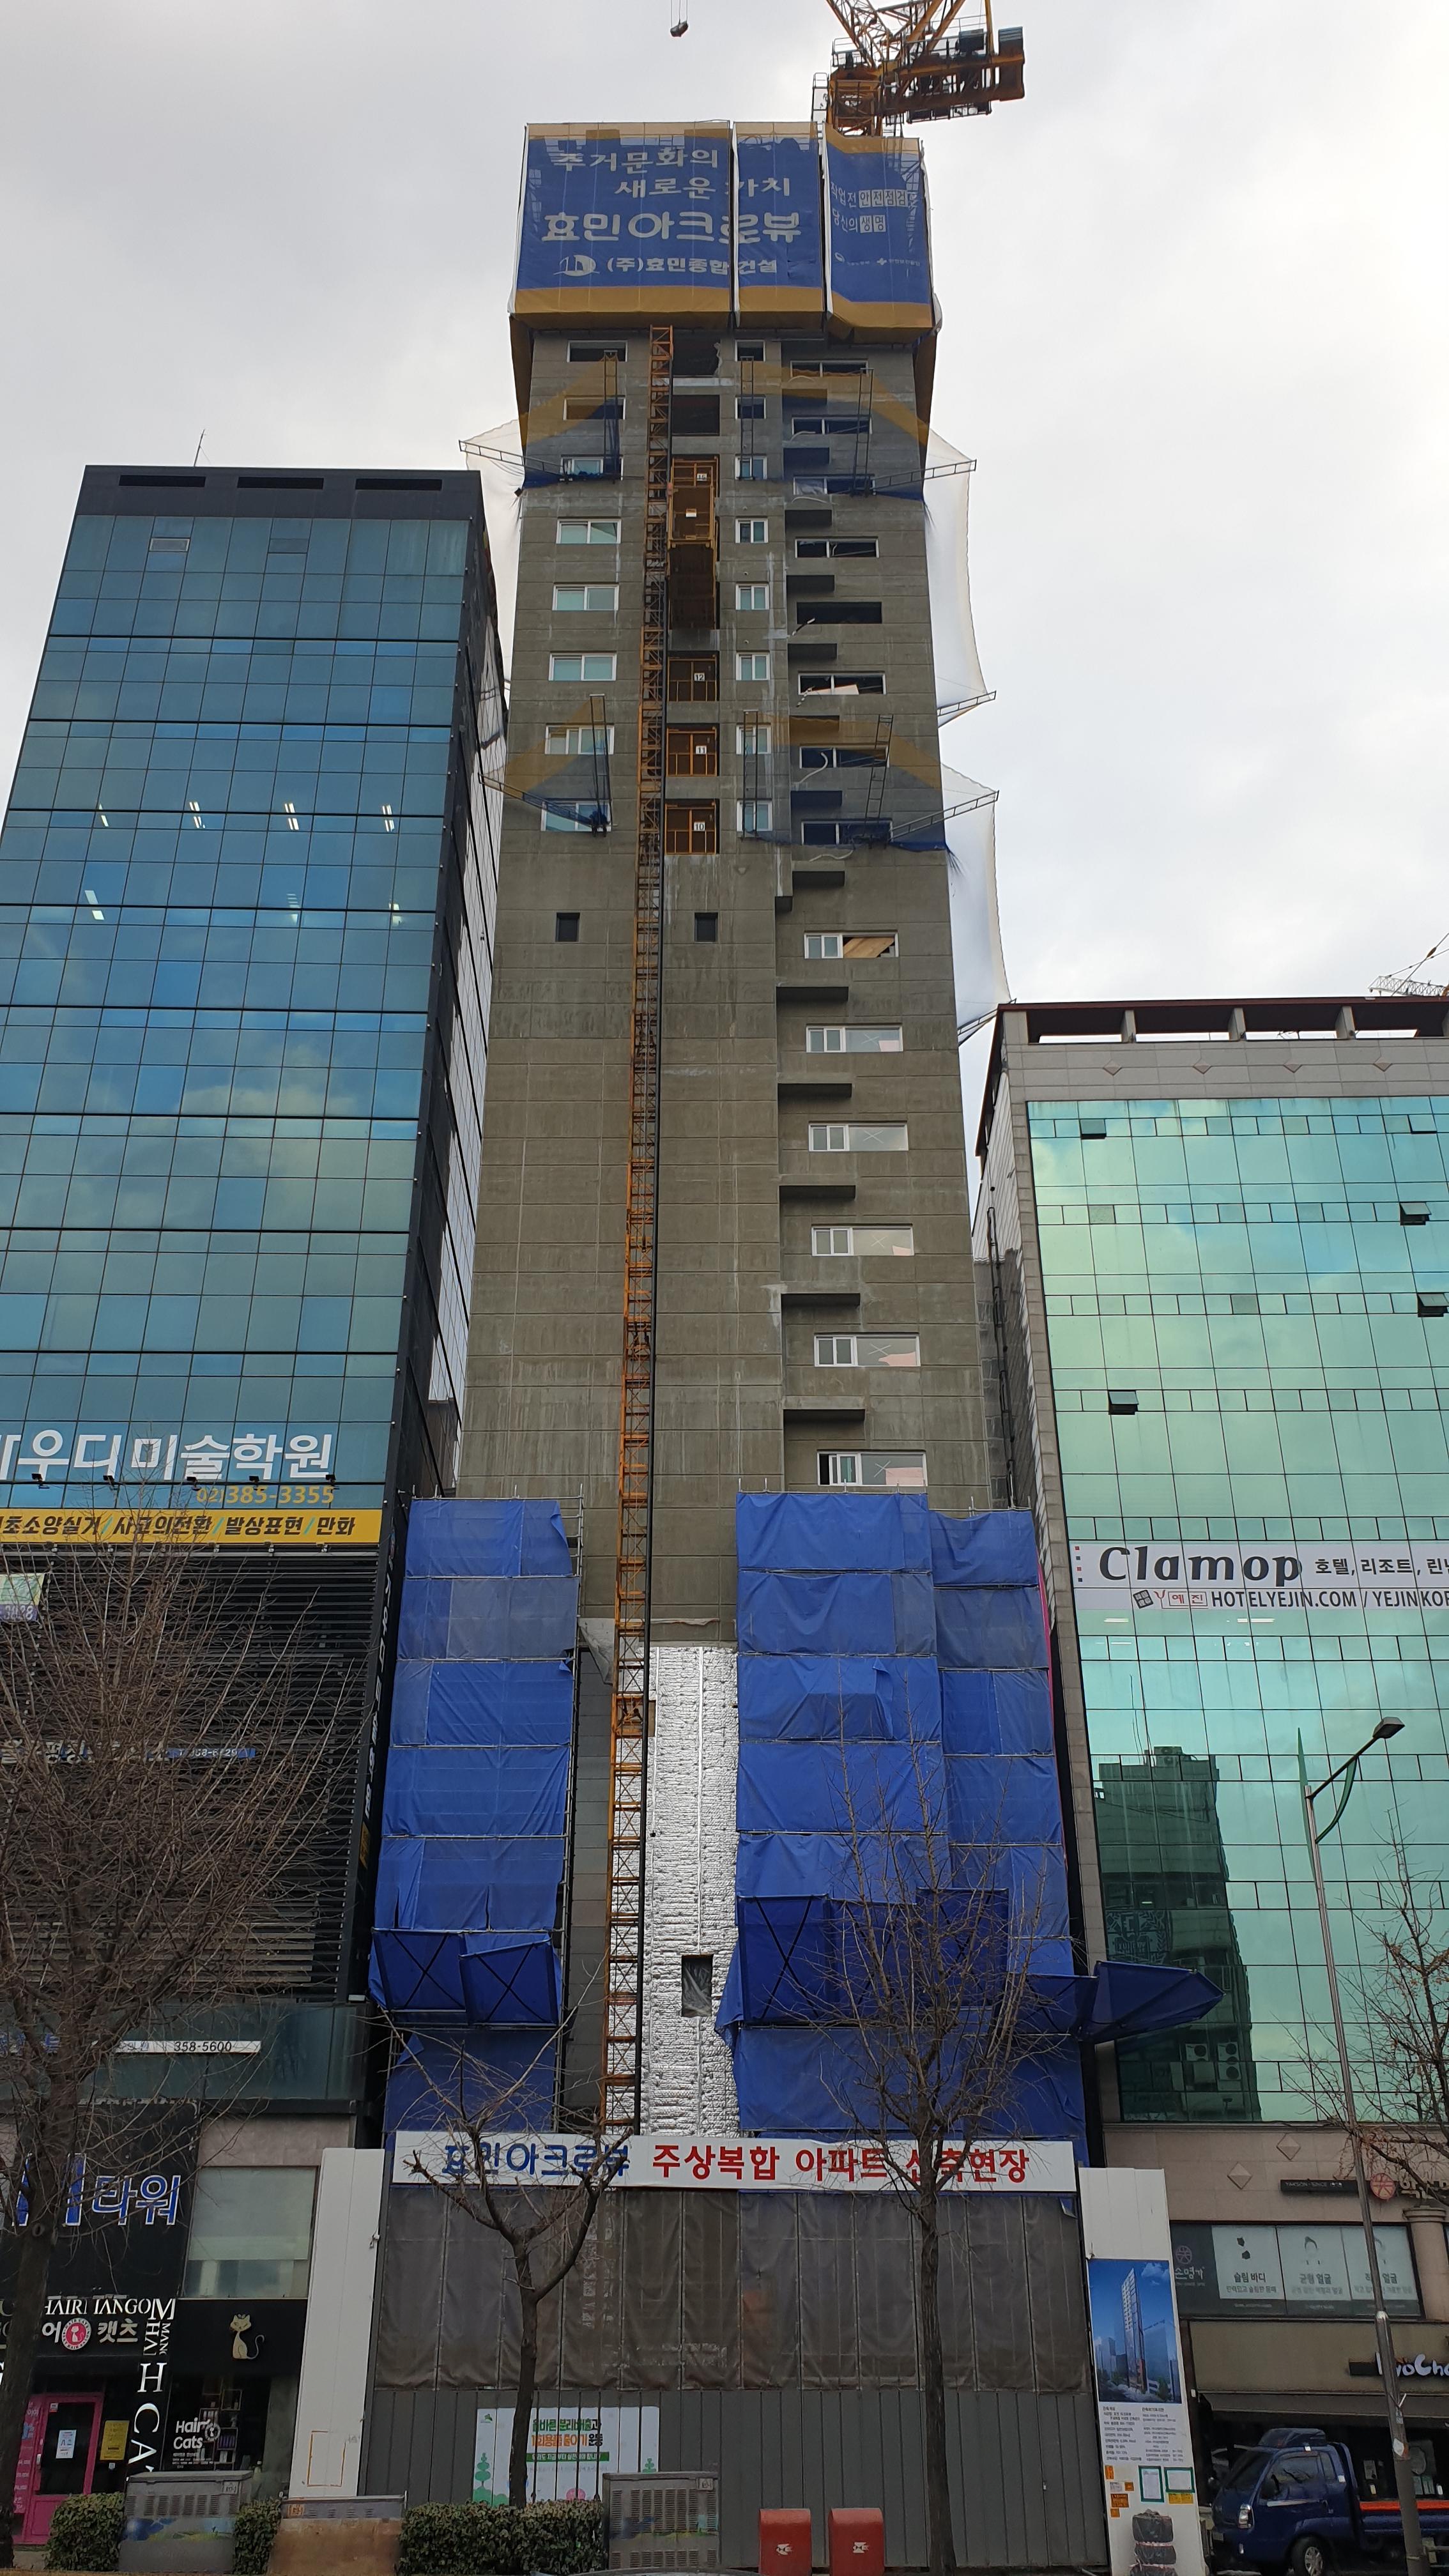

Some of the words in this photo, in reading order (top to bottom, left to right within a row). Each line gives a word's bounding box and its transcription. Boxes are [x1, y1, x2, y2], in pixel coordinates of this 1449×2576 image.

[554, 147, 719, 174] 주거문화의
[614, 176, 717, 199] 새로운
[541, 211, 802, 244] 효민아크로뷰
[832, 208, 858, 233] 당신의
[860, 215, 885, 232] 생명
[0, 1515, 101, 1535] 초소양실기
[225, 1516, 304, 1535] 발상표현
[316, 1516, 355, 1535] 만화
[1099, 1545, 1303, 1587] Clamop
[1213, 1590, 1357, 1608] HOTELYEJIN.COM
[173, 2041, 233, 2052] 358-5600
[441, 2141, 629, 2176] 효민아크로뷰
[652, 2144, 780, 2180] 주상복합
[795, 2147, 889, 2182] 아파트
[905, 2149, 1029, 2184] 신축현장
[1175, 2266, 1206, 2280] 손명가
[97, 2318, 139, 2343] 캣츠
[175, 2417, 211, 2434] Hair
[173, 2435, 203, 2450] Cats
